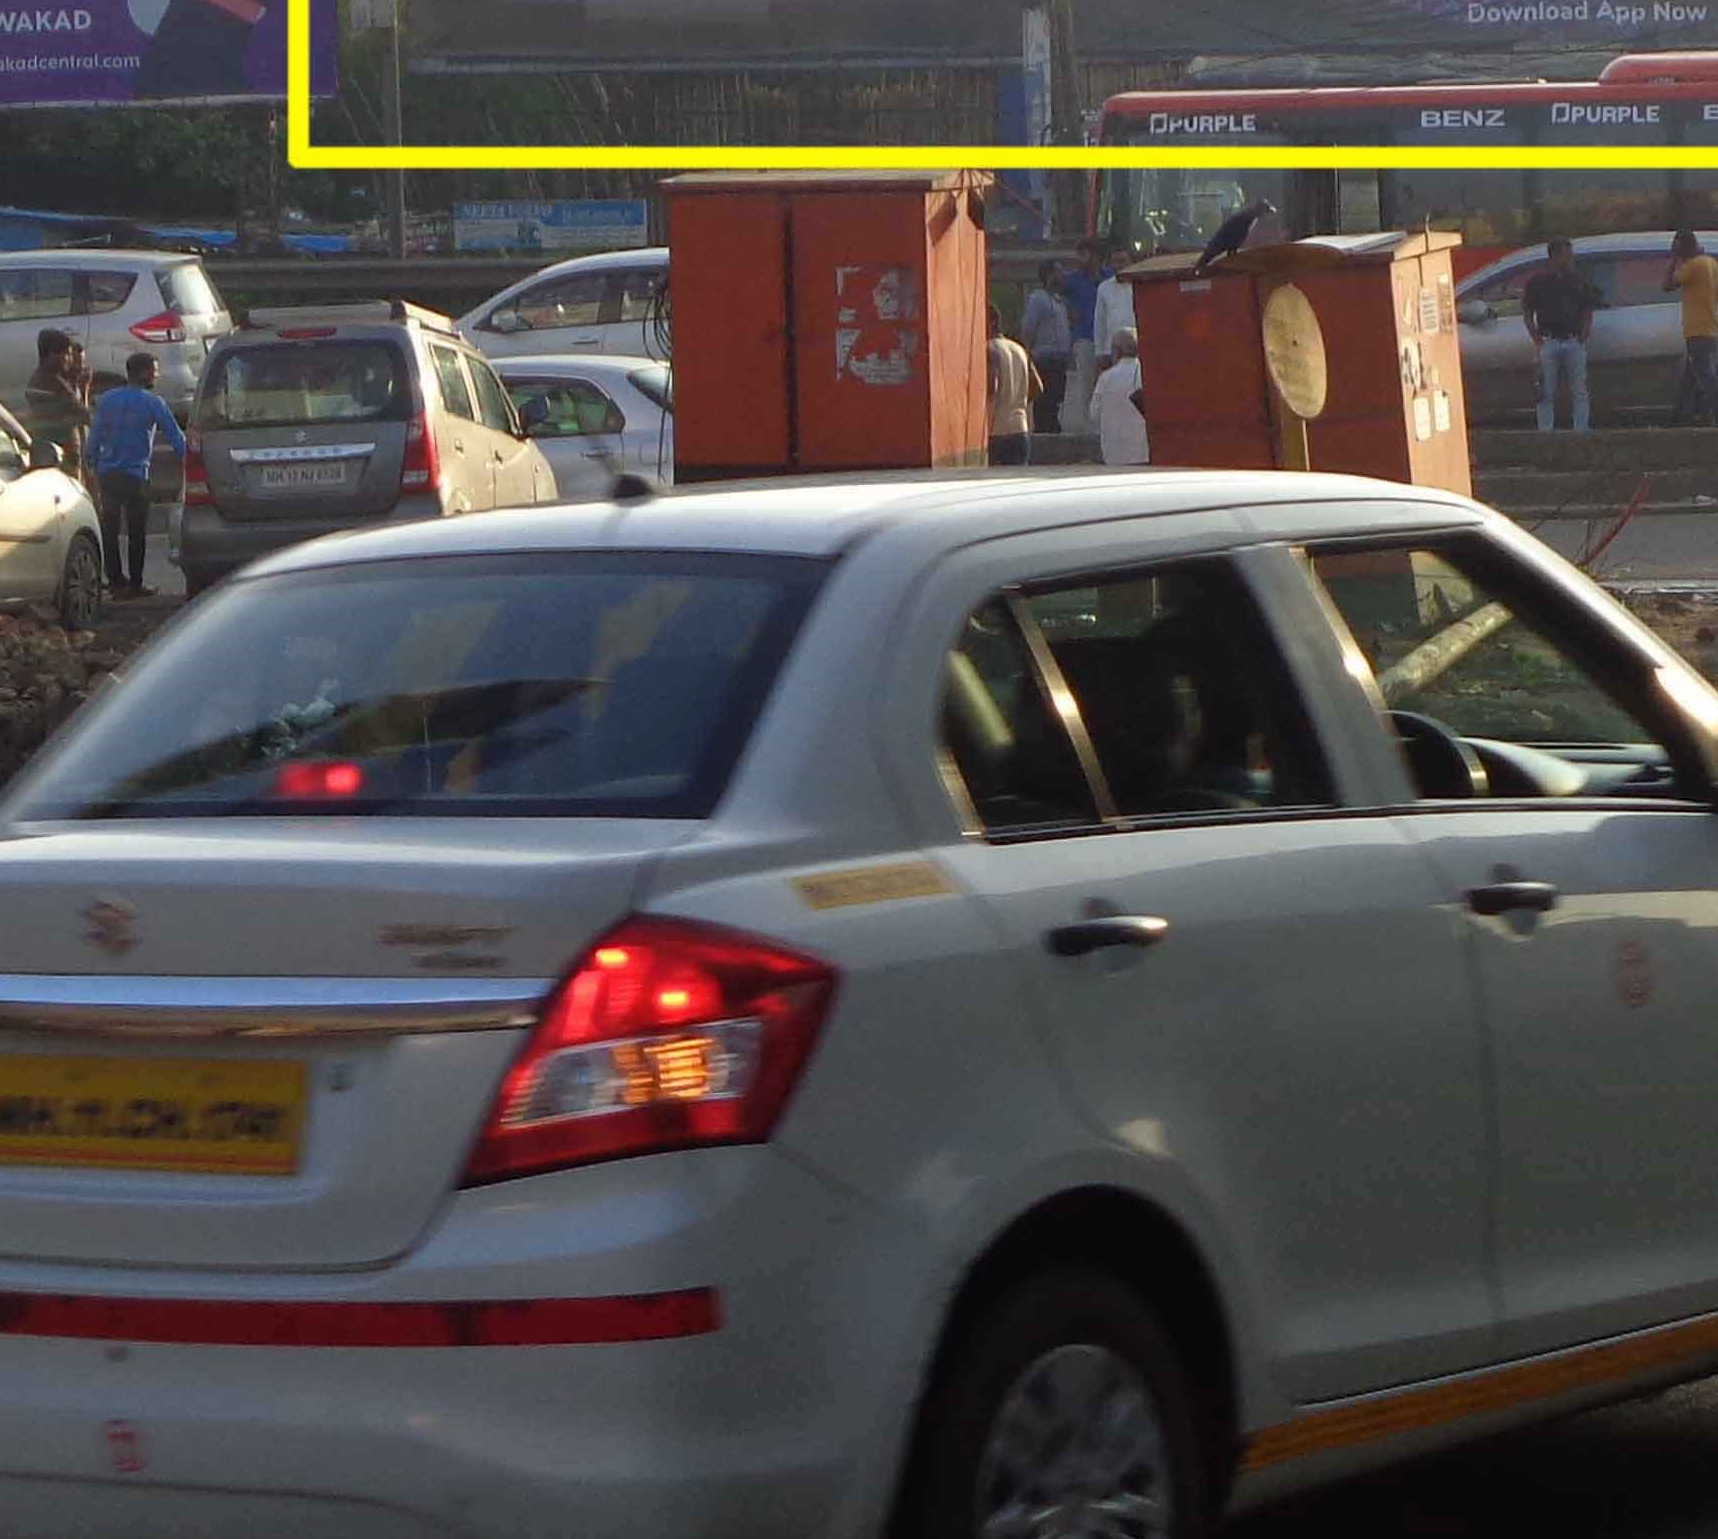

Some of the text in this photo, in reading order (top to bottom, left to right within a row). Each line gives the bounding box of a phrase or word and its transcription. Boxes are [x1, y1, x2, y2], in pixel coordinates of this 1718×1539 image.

[1467, 0, 1708, 24] Download App Now
[1168, 113, 1257, 135] PURPLE
[1420, 108, 1506, 129] BENZ
[1569, 104, 1660, 124] PURPLE
